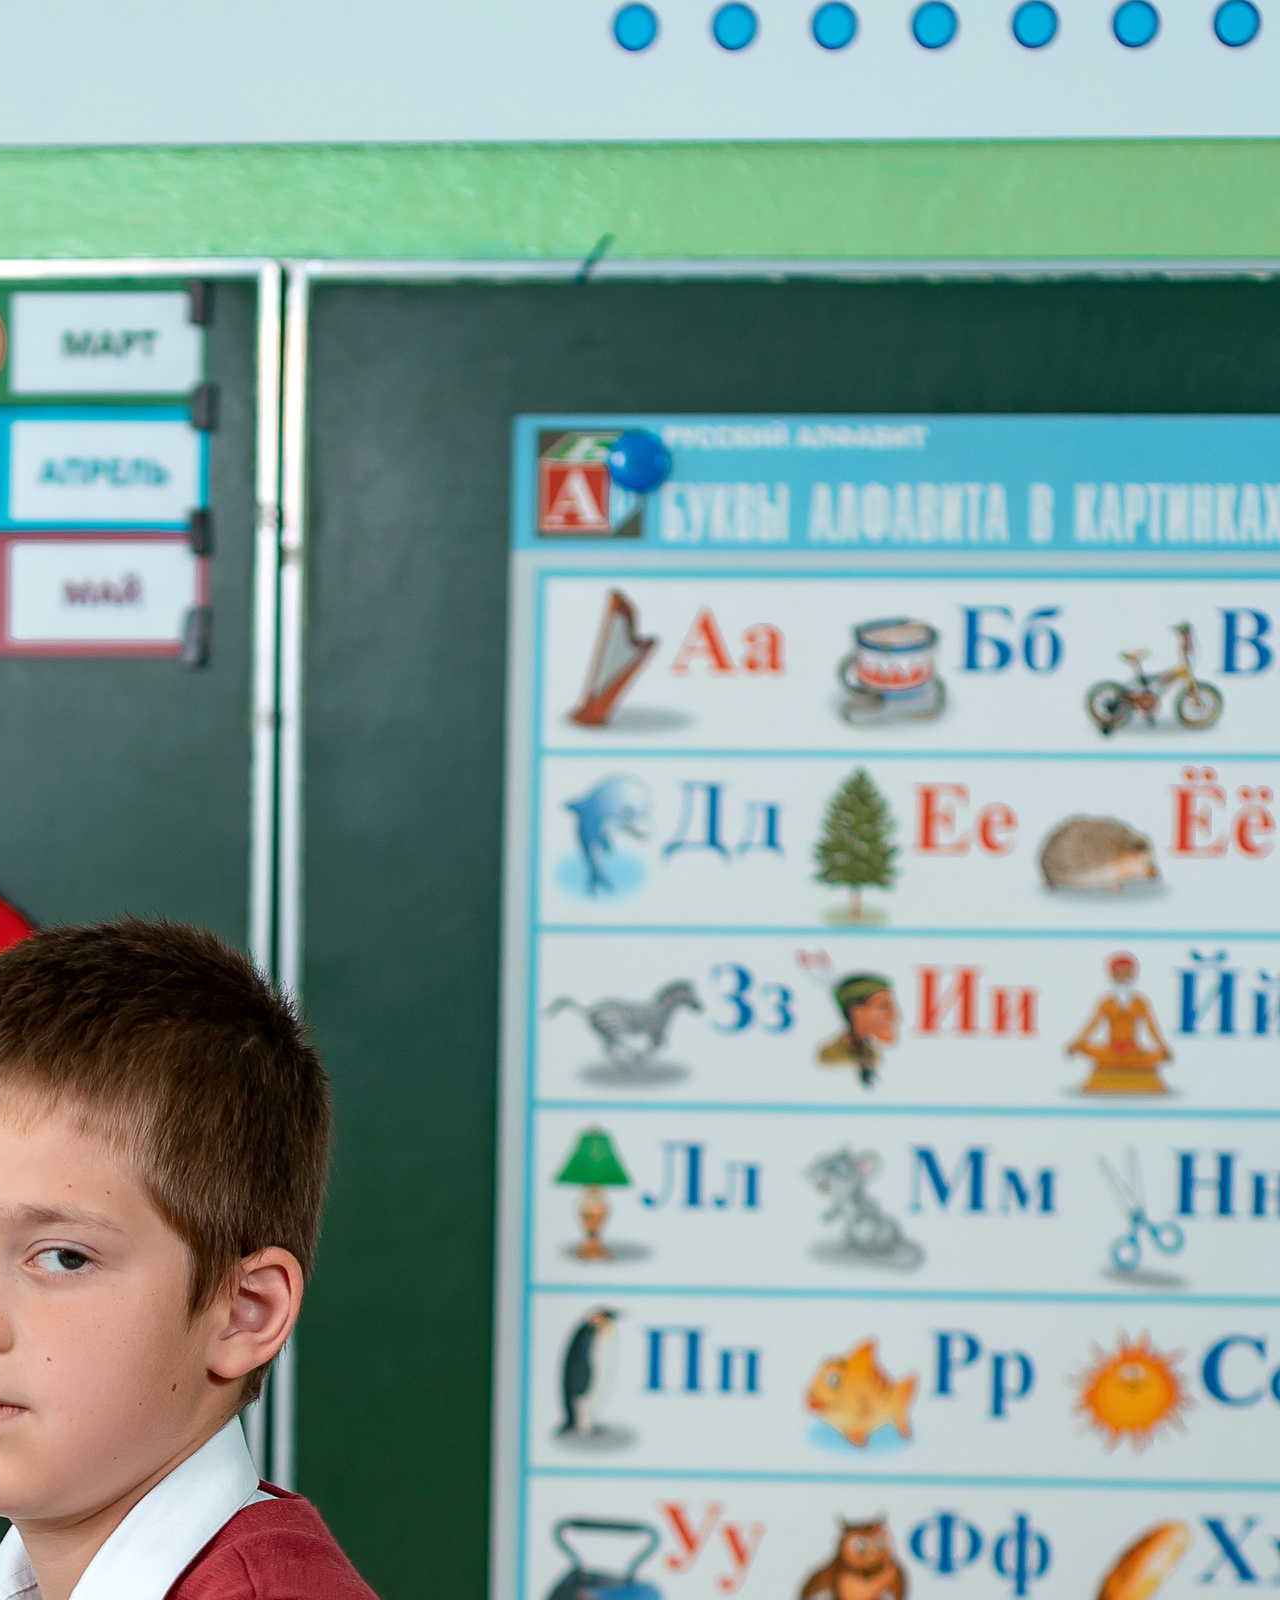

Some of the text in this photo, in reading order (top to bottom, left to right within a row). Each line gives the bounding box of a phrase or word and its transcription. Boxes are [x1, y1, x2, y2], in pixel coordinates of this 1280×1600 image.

[61, 329, 158, 361] МАРТ
[40, 456, 169, 488] АПРЕЛЬ
[661, 481, 790, 544] БУКВЫ
[807, 481, 1010, 545] АЛФАВИТА
[1027, 482, 1055, 545] В
[65, 573, 142, 609] МАЙ
[669, 606, 787, 676] Аа
[958, 605, 1067, 675] Бб
[661, 767, 1276, 861] Дд Ее Ёё
[707, 963, 796, 1035] Зз
[914, 965, 1039, 1038] Ии
[641, 1142, 763, 1212] Лл
[909, 1146, 1058, 1217] Мм
[641, 1325, 763, 1395] Пп
[931, 1330, 1036, 1420] Рр
[661, 1501, 765, 1595] Уу
[909, 1512, 1051, 1599] Фф
